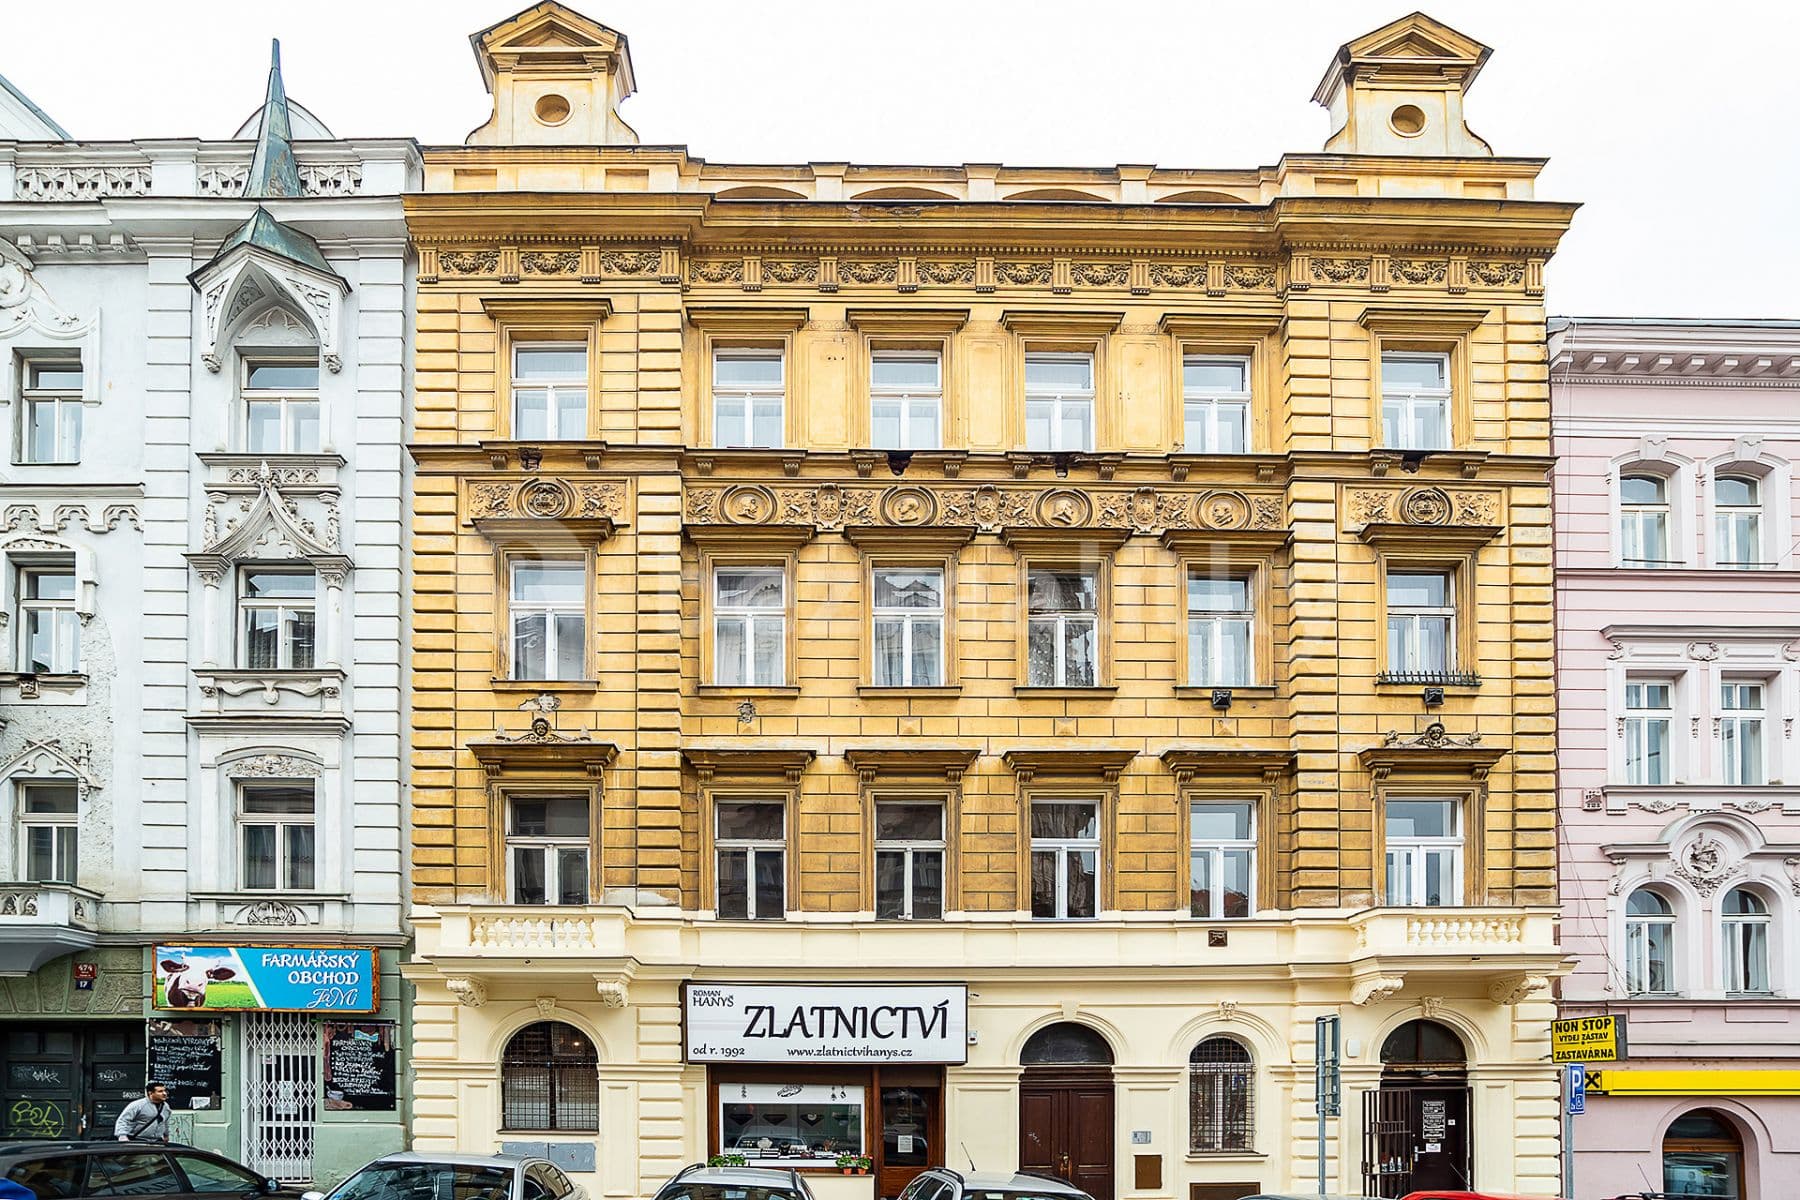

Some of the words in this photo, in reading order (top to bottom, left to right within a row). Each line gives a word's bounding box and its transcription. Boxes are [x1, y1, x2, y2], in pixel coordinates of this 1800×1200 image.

[261, 950, 360, 969] FARMÁŘSKÝ
[79, 980, 88, 988] 17
[288, 971, 359, 985] OBCHOD
[692, 995, 735, 1008] HANYŠ
[742, 999, 950, 1039] ZLATNICTVÍ
[1555, 1021, 1578, 1033] NON
[1581, 1018, 1612, 1031] STOP
[1559, 1033, 1579, 1042] VÝDEJ
[1581, 1031, 1608, 1041] ZÁSTAV
[692, 1045, 707, 1055] od
[709, 1047, 718, 1055] r.
[720, 1047, 746, 1057] 1992
[786, 1045, 913, 1060] www.zlatnictvihanys.cz
[1555, 1047, 1615, 1060] ZASTAVÁRNA
[1571, 1070, 1582, 1098] P
